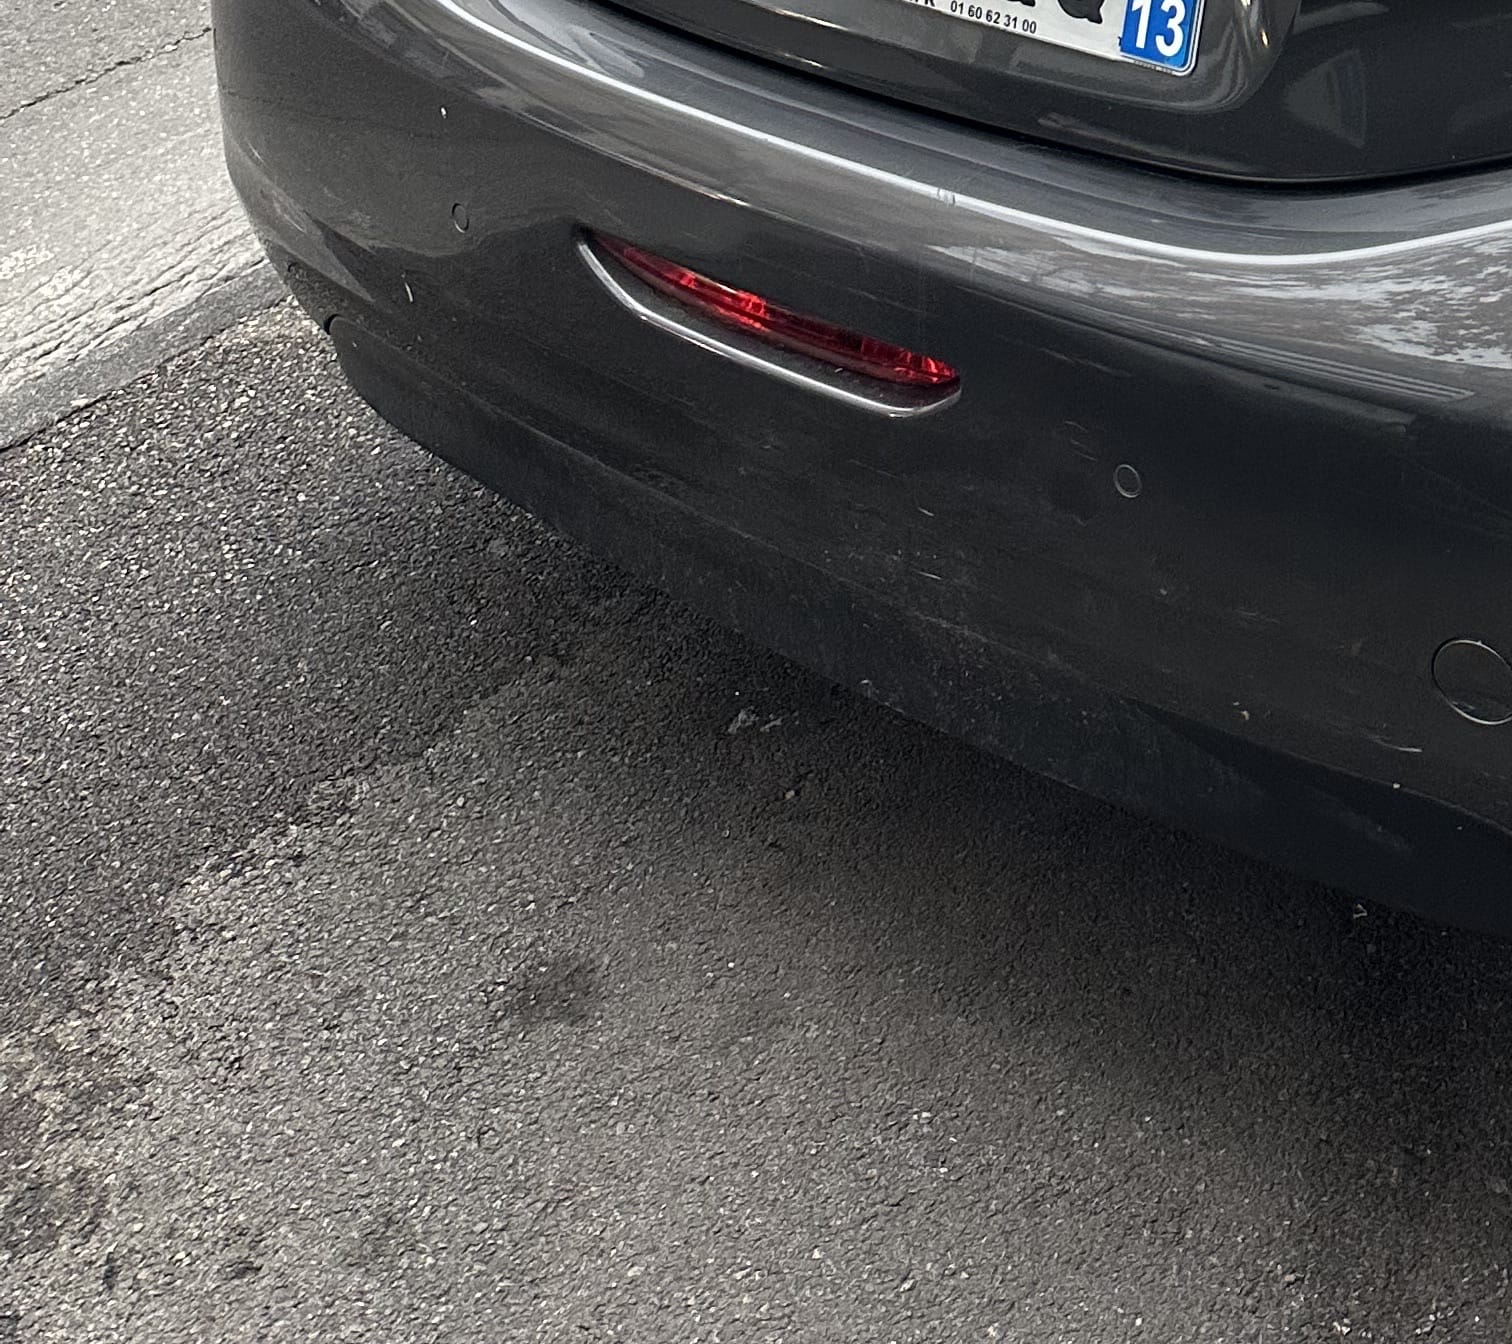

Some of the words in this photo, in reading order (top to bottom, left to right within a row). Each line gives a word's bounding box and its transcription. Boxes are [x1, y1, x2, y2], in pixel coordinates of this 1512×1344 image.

[950, 0, 964, 14] 01
[967, 5, 982, 20] 60
[985, 9, 1000, 25] 62
[1003, 13, 1017, 29] 31
[1022, 18, 1037, 34] 00
